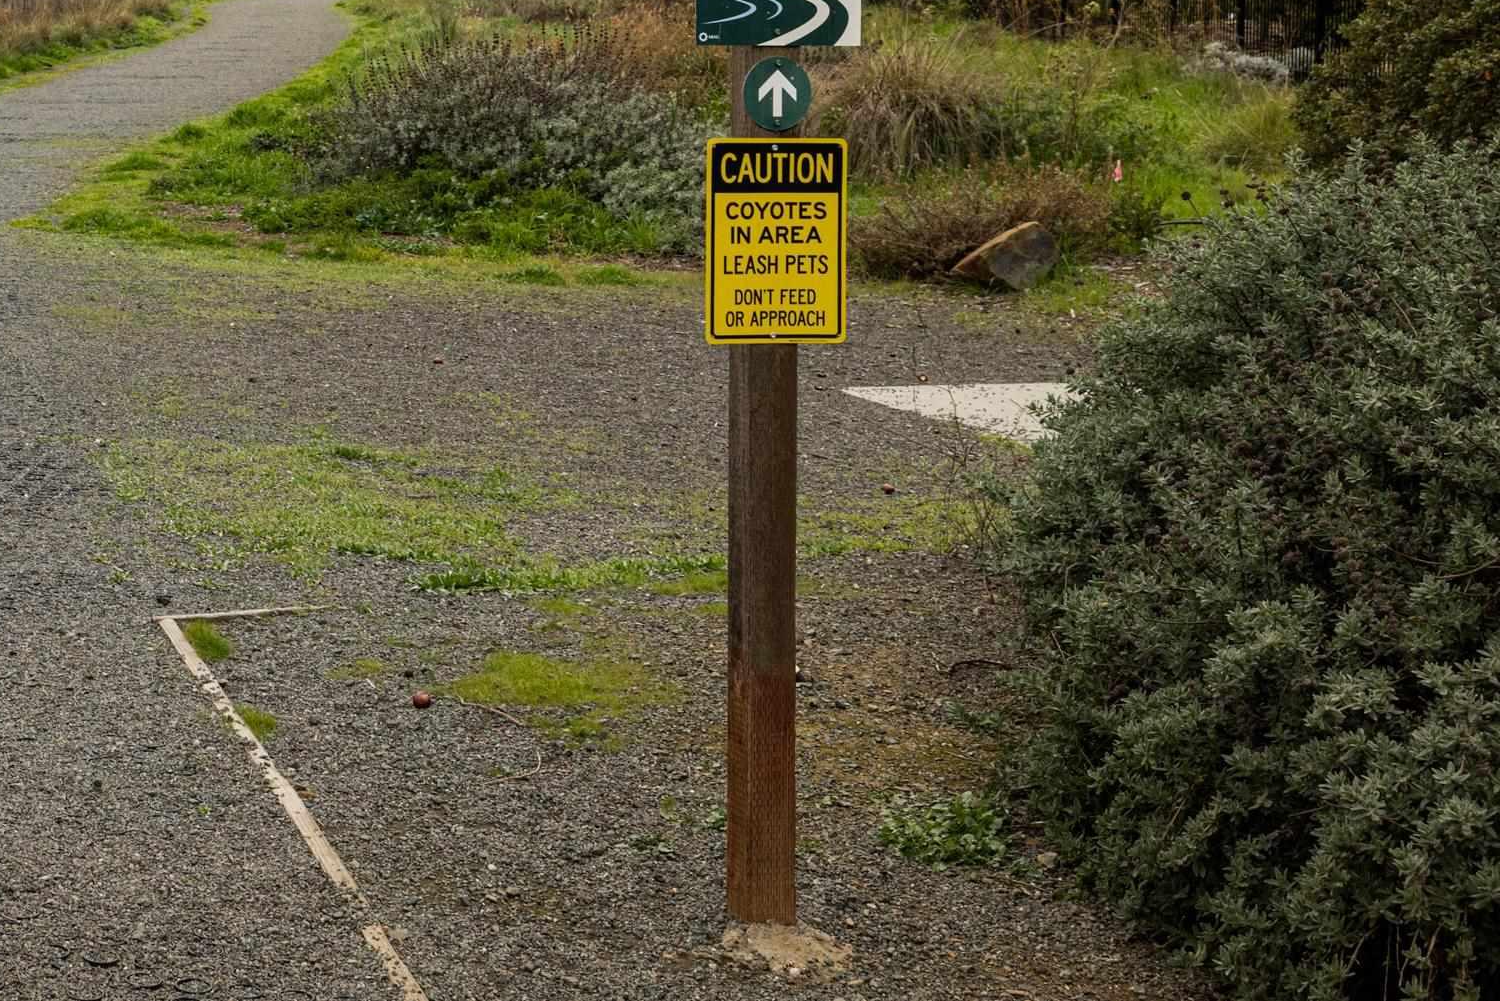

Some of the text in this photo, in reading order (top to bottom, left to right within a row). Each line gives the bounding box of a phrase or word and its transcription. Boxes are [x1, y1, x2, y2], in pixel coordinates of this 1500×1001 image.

[720, 152, 834, 184] CAUTION
[725, 201, 827, 220] COYOTES
[730, 226, 822, 244] IN AREA
[723, 255, 829, 275] LEASH PETS
[734, 289, 816, 305] DON'T FEED
[725, 310, 826, 327] OR APPROACH
